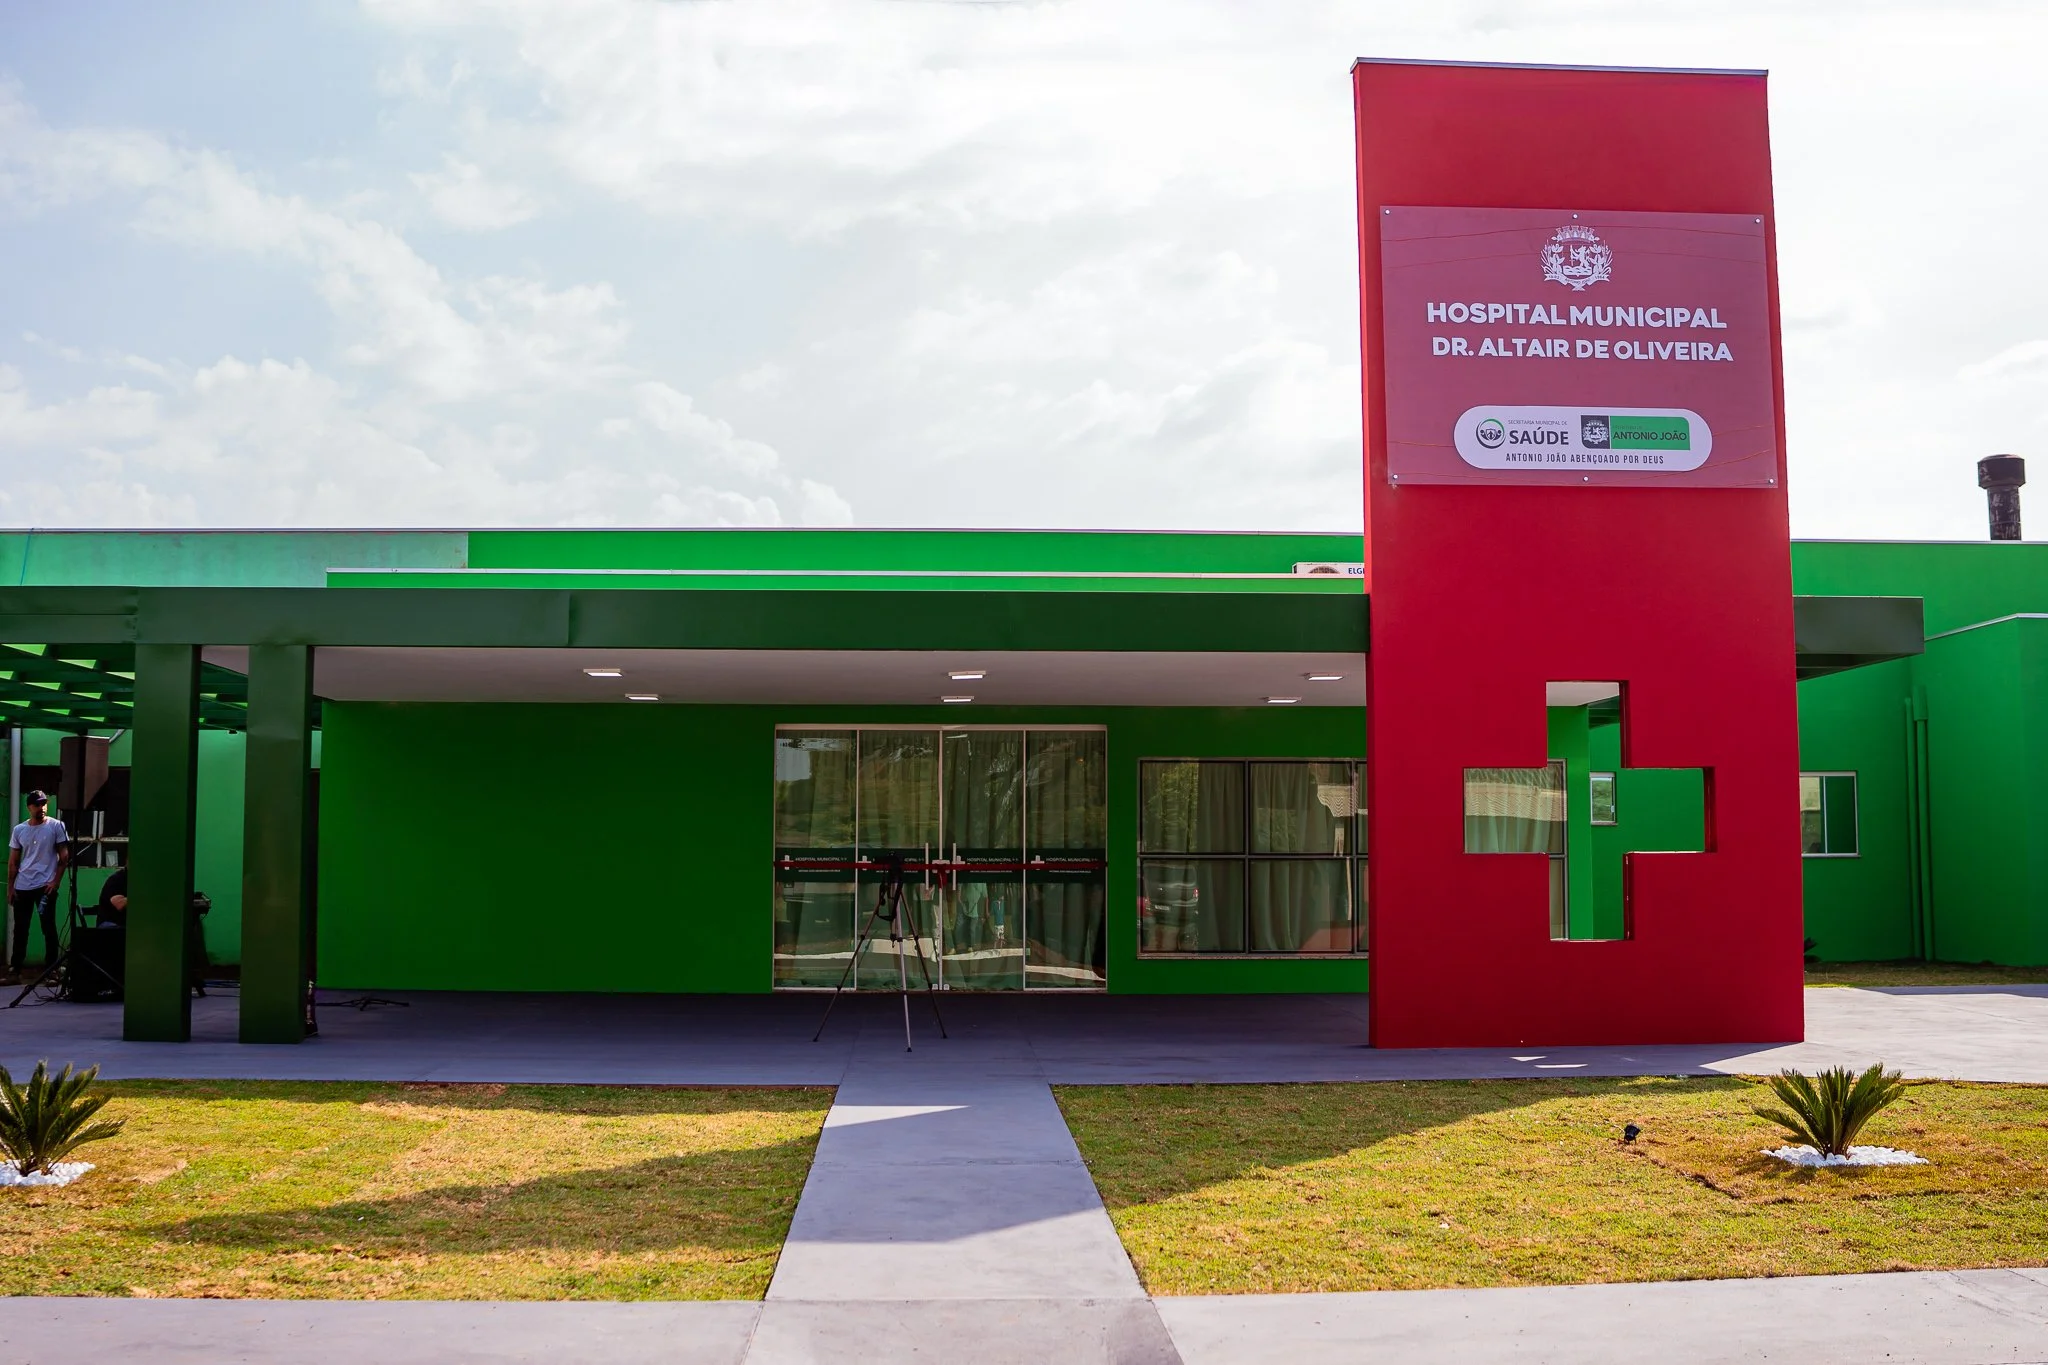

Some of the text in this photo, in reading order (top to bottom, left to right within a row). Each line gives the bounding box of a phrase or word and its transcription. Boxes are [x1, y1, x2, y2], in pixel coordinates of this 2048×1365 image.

[1427, 302, 1728, 329] HOSPITAL MUNICIPAL
[1432, 336, 1734, 362] DR. ALTAIR DE OLIVEIRA
[1509, 426, 1569, 445] SAÚDE
[1612, 430, 1687, 441] ANTONIO JOÃO
[1505, 452, 1664, 464] ANTONIO JOÃO ABENÇOADO POR DEUS
